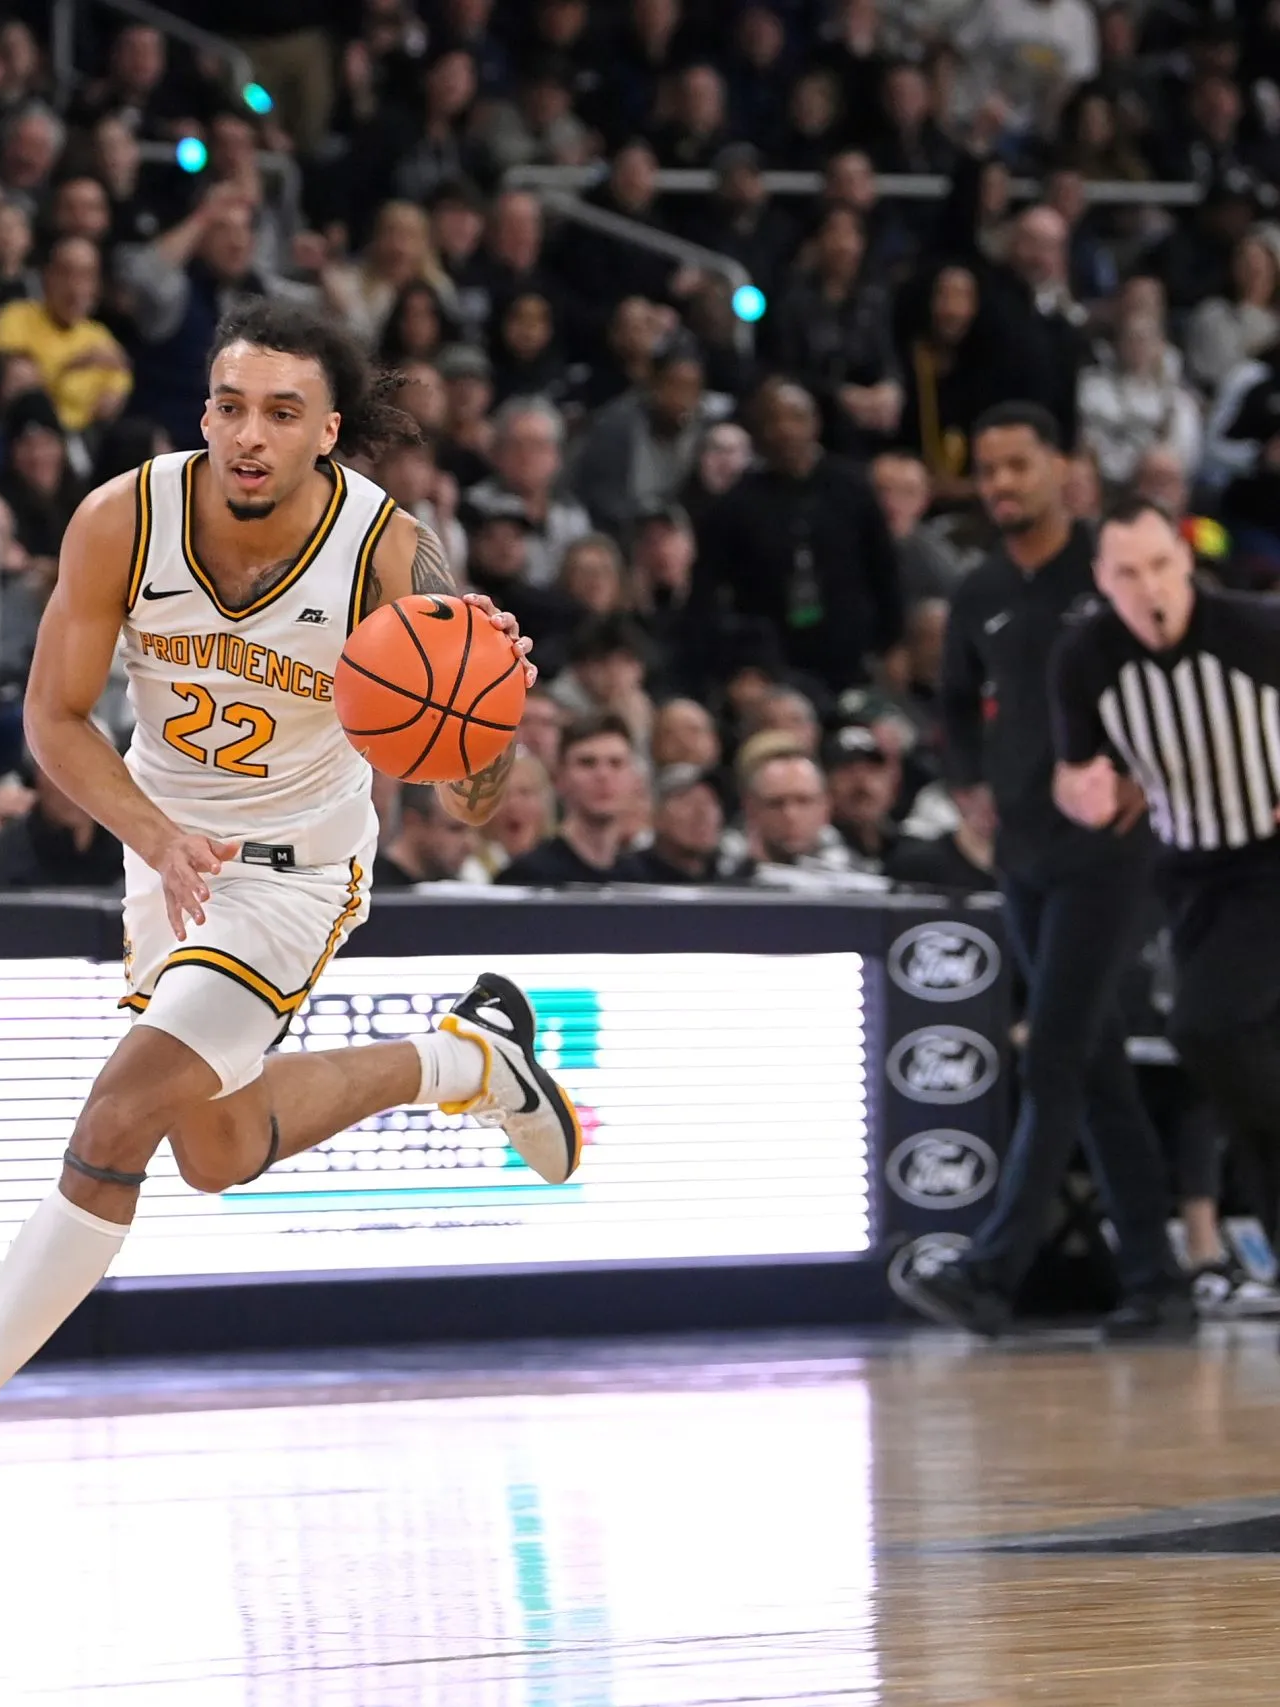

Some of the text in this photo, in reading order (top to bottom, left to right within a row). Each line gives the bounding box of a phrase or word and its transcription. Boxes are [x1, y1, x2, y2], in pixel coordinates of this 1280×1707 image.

[140, 631, 335, 702] PROVIDENCE
[163, 681, 276, 778] 22
[277, 852, 288, 862] M
